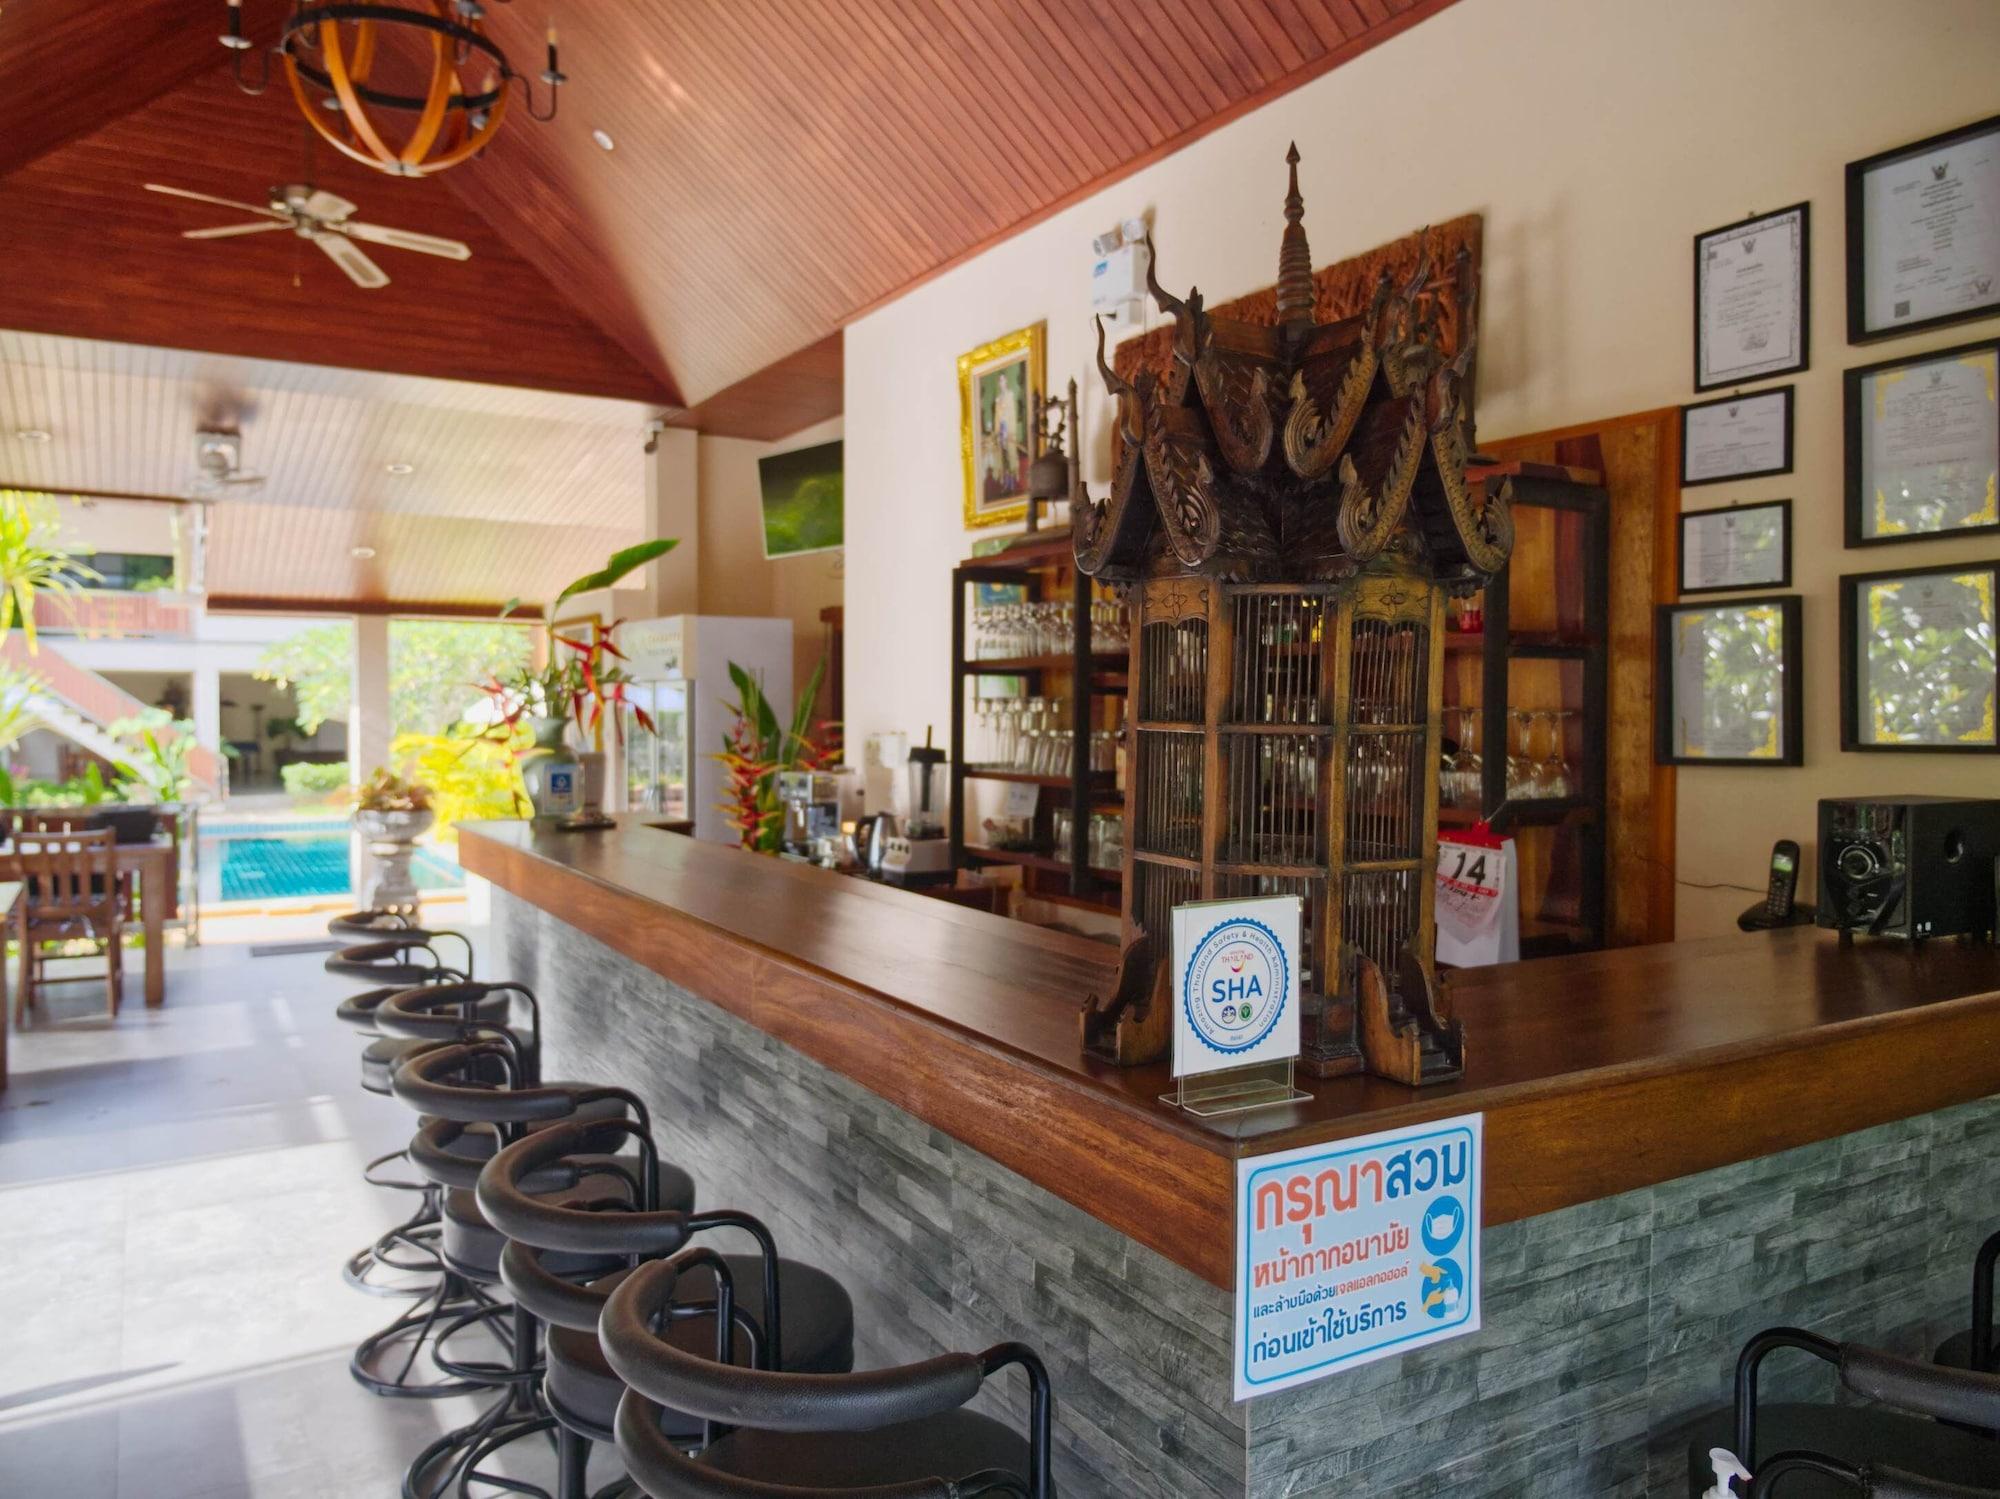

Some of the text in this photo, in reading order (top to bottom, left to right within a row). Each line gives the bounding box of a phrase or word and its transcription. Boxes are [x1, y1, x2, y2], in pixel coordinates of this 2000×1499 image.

[1452, 852, 1486, 885] 14
[1213, 932, 1239, 949] Safety
[1250, 932, 1273, 955] Health
[1193, 948, 1213, 992] Thailand
[1211, 974, 1262, 1003] SHA
[1259, 955, 1281, 1028] Administration
[1194, 997, 1215, 1035] Amazing
[1256, 1140, 1466, 1244] กรุณาสวม
[1253, 1222, 1409, 1288] หน้ากากอนามัย
[1253, 1260, 1410, 1318] และล้างมือด้วยเจลแอลกอฮอล์
[1253, 1300, 1407, 1363] ก่อนเข้าใช้บริการ
